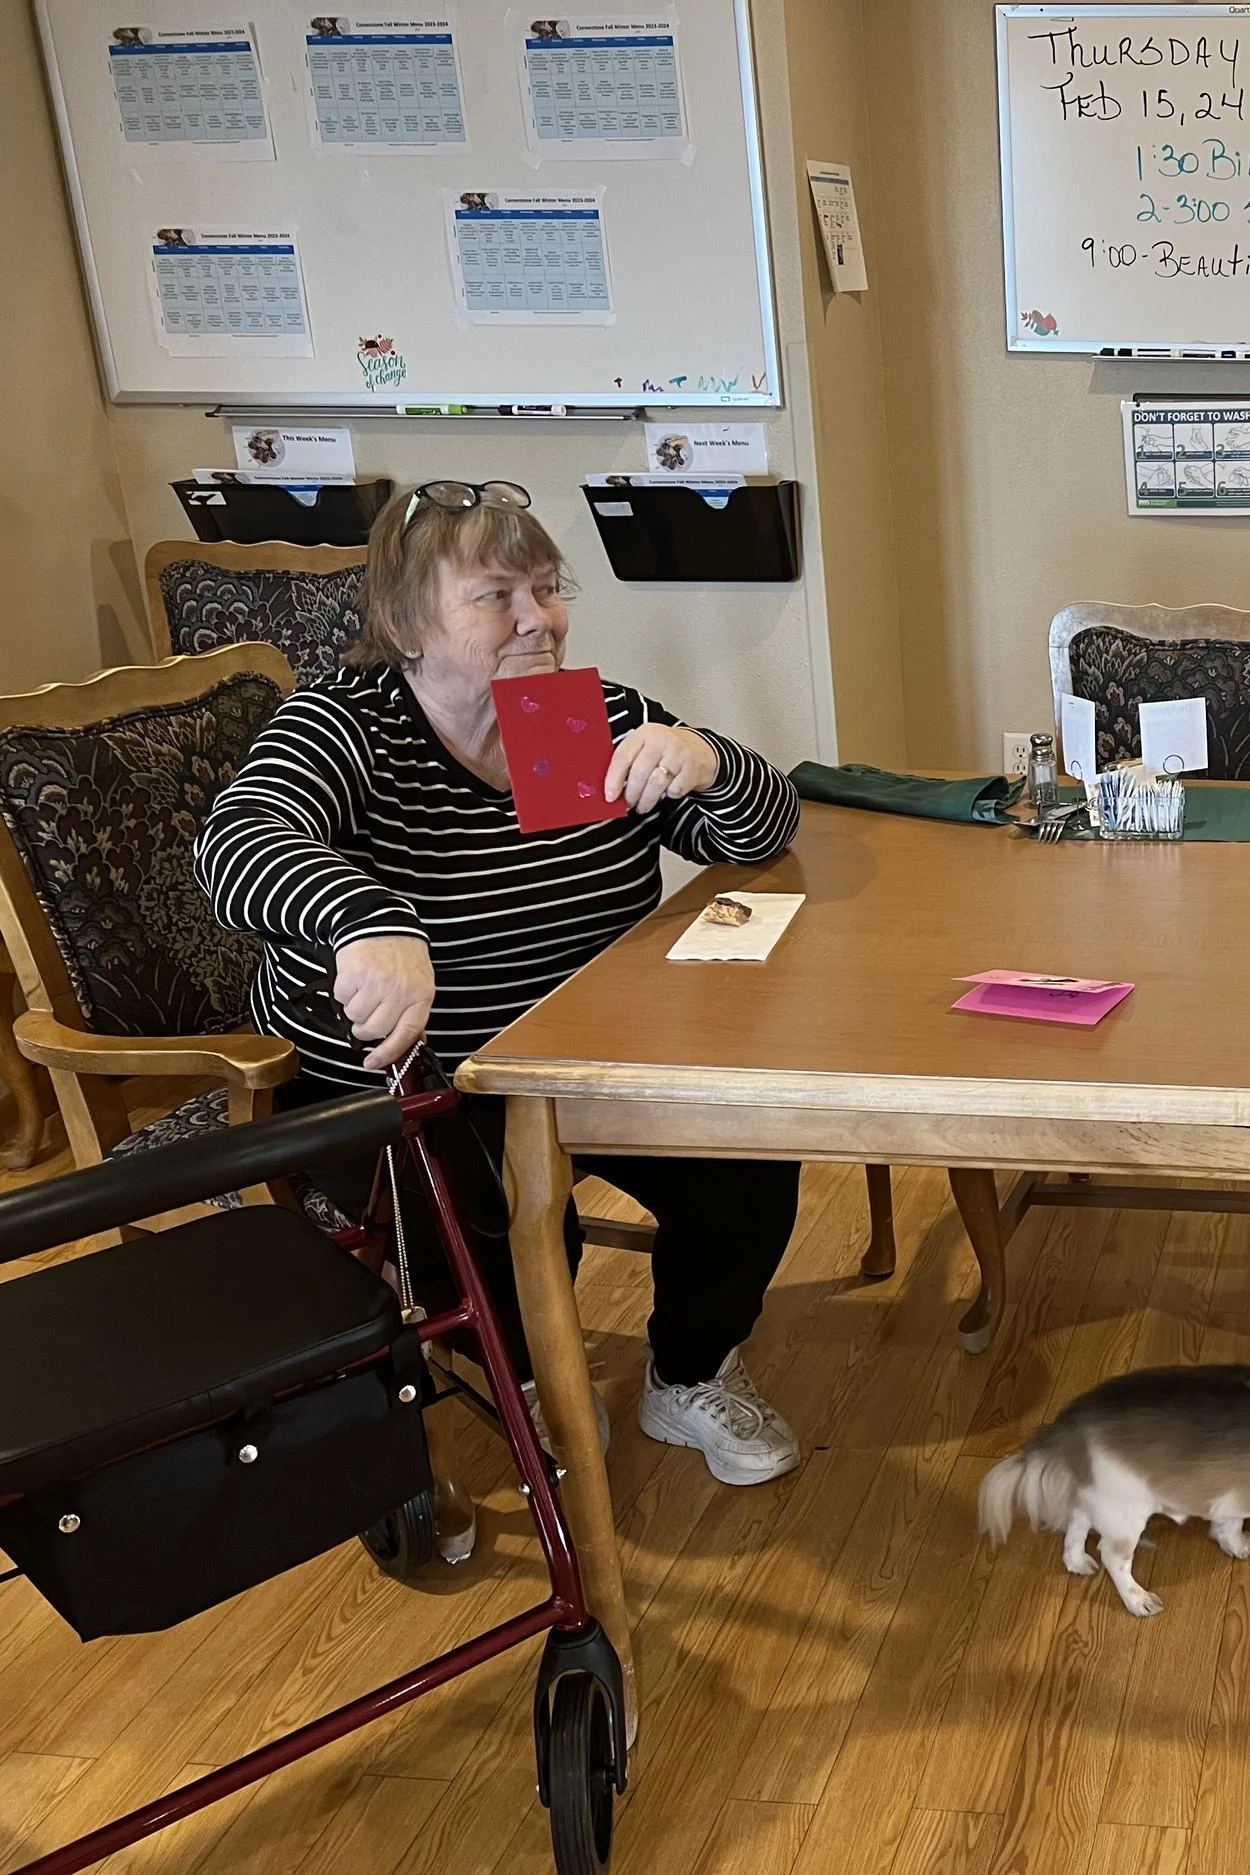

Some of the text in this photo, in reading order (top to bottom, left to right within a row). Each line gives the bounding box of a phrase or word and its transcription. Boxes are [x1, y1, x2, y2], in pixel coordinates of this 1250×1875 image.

[1137, 144, 1199, 181] 1:30
[357, 352, 406, 376] Season
[366, 369, 406, 392] of change
[1134, 412, 1165, 422] DON'T
[1168, 412, 1206, 422] FORGET
[1208, 412, 1220, 421] TO
[1138, 444, 1147, 458] 1
[1176, 444, 1187, 458] 2
[1216, 444, 1226, 458] 3
[1139, 482, 1149, 496] 4
[1178, 482, 1188, 496] 5
[1217, 481, 1226, 496] 6
